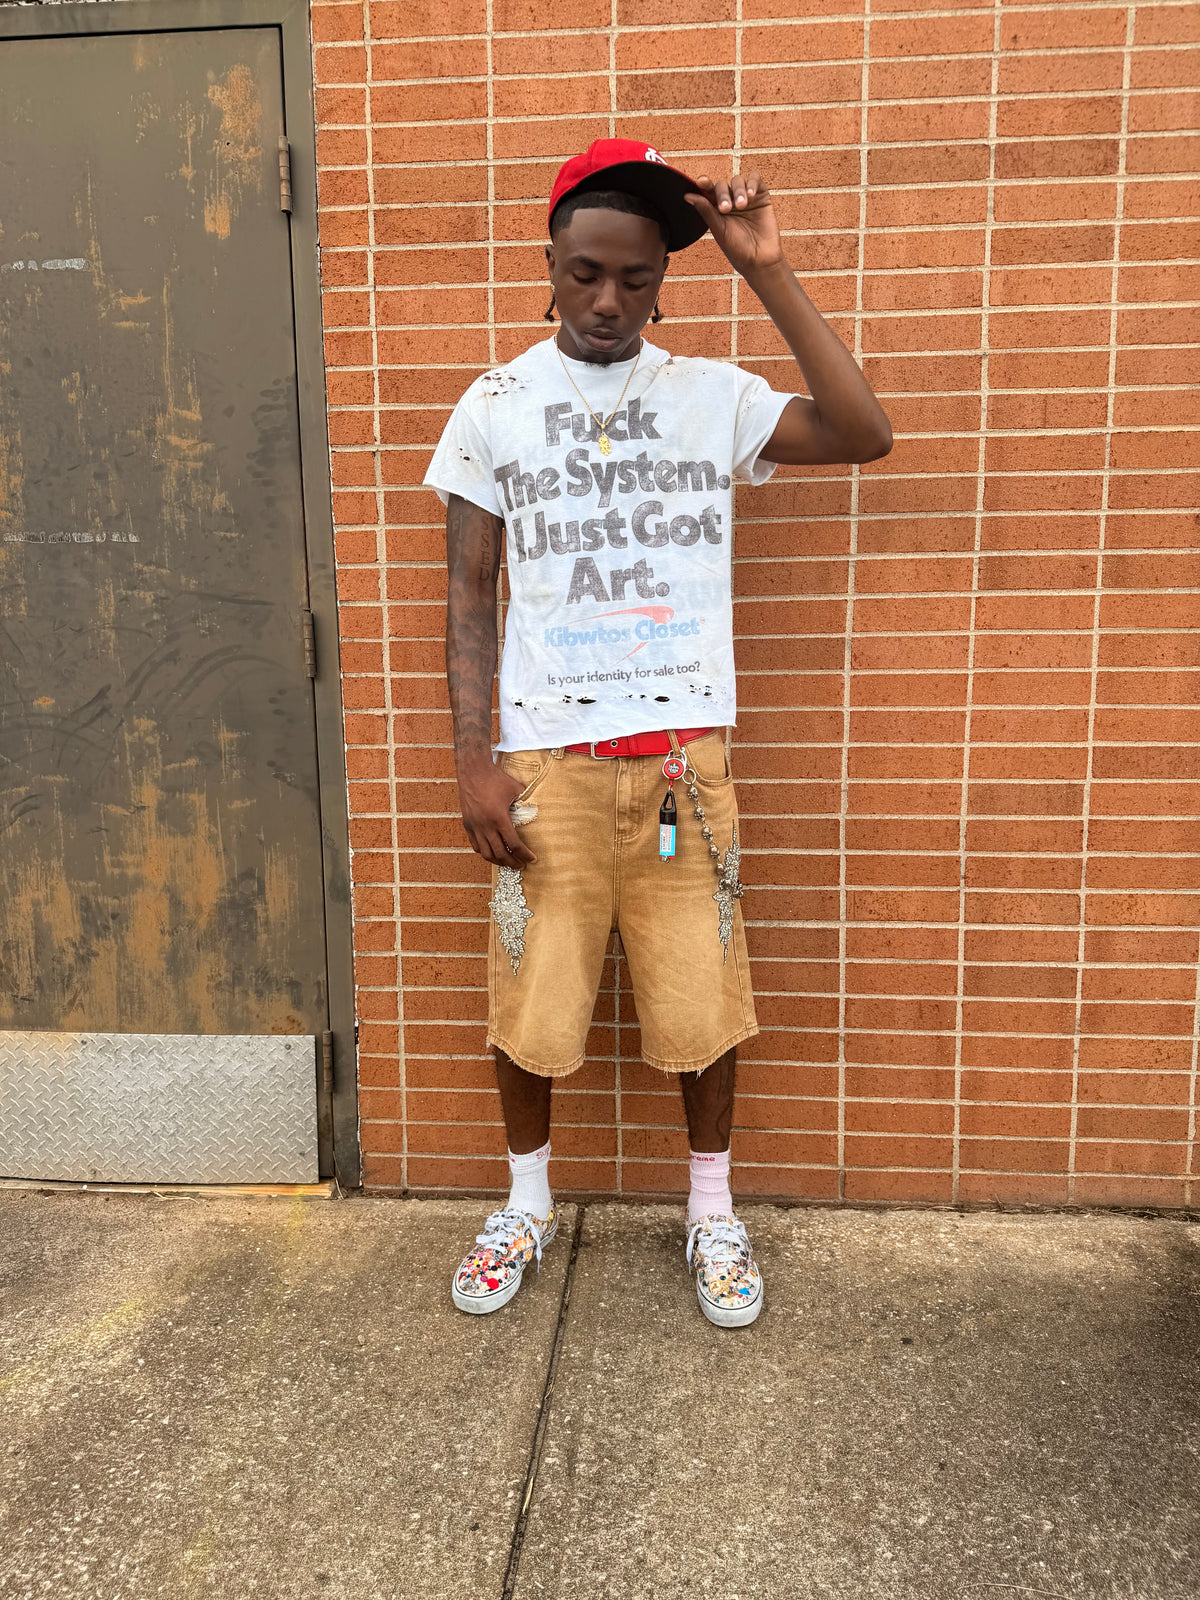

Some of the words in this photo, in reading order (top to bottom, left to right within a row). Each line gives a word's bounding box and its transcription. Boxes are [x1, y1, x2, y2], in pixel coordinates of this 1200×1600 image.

[544, 397, 663, 447] Fuck
[494, 459, 562, 512] The
[565, 448, 731, 508] System.
[512, 517, 527, 563] I
[528, 507, 628, 560] Just
[631, 500, 722, 548] Got
[565, 556, 670, 605] Art.
[543, 625, 631, 648] Kibwtos
[634, 617, 700, 641] Closet
[547, 674, 556, 685] Is
[558, 674, 585, 687] your
[587, 669, 632, 683] identity
[634, 667, 652, 679] for
[653, 664, 674, 677] sale
[676, 661, 701, 674] too?
[690, 1154, 716, 1162] reme
